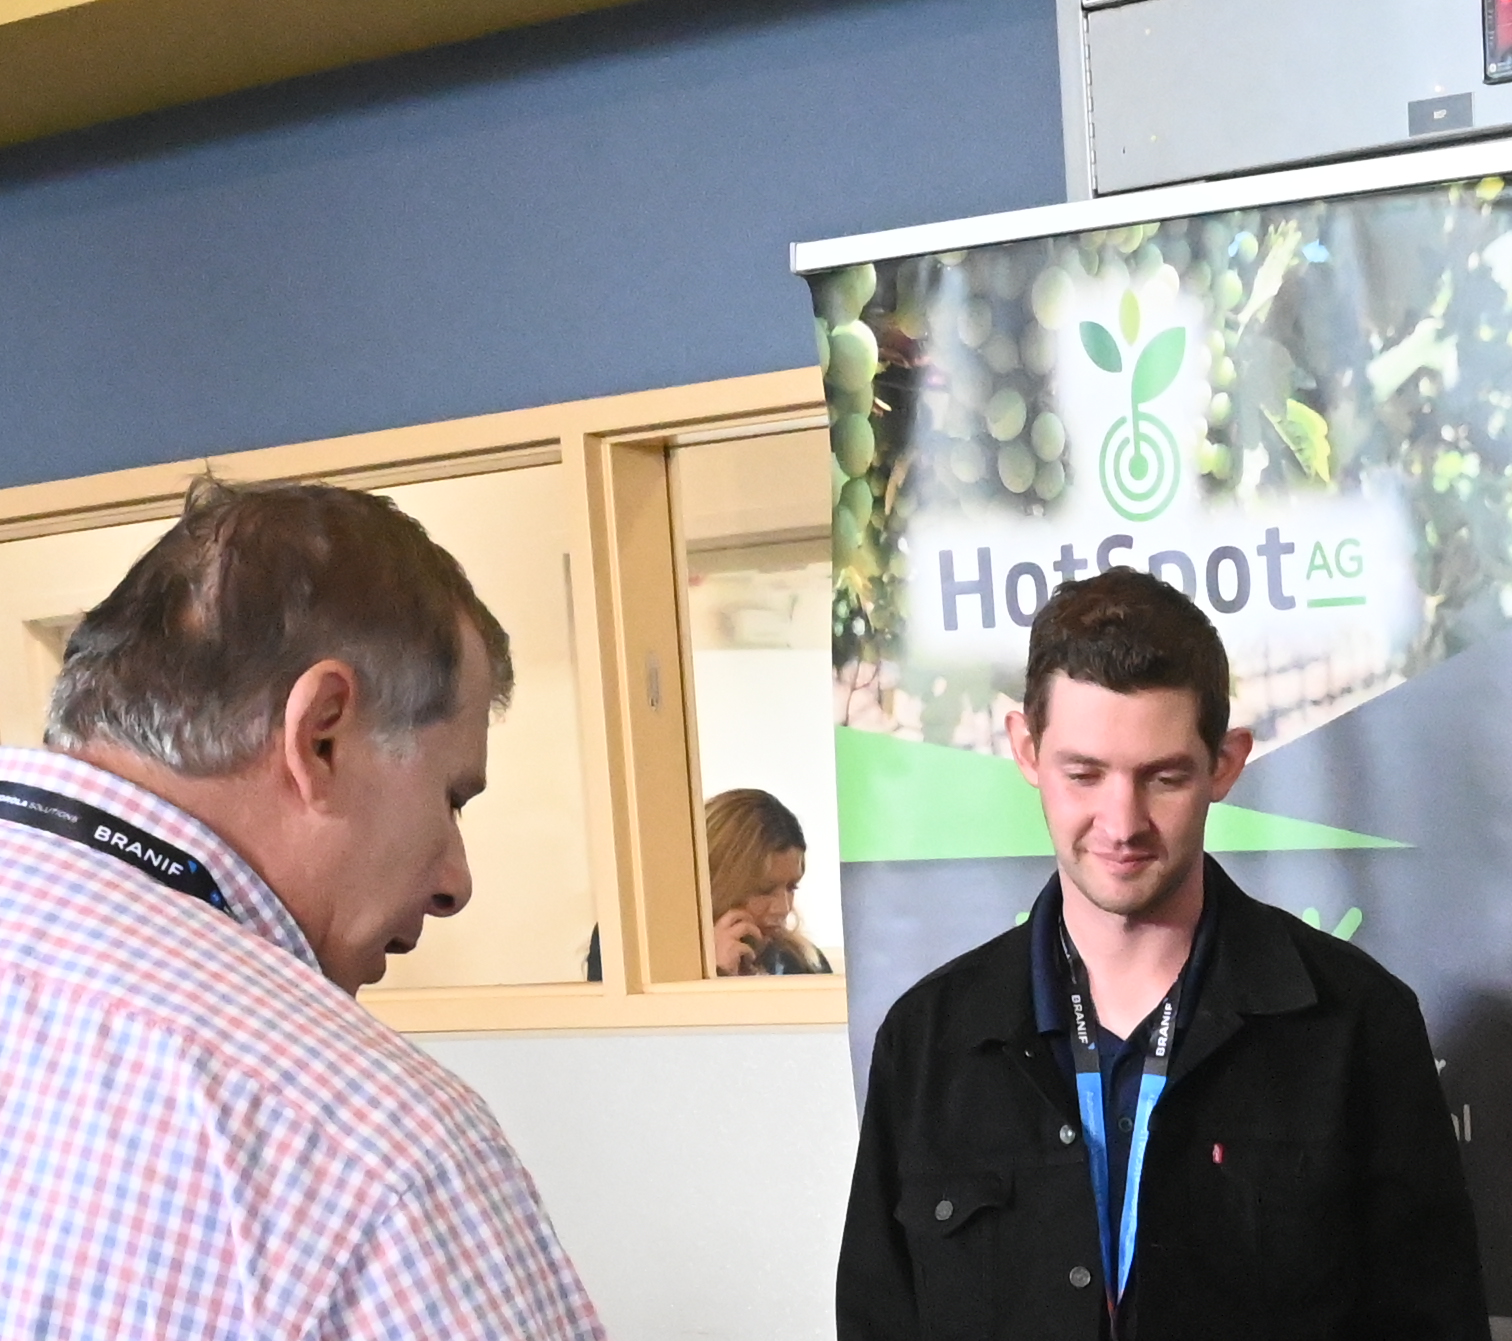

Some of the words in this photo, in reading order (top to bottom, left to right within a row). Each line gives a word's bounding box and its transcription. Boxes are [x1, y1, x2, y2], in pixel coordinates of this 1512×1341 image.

[1306, 537, 1364, 581] AG
[93, 825, 184, 877] BRANIF
[1071, 994, 1089, 1045] BRANIF
